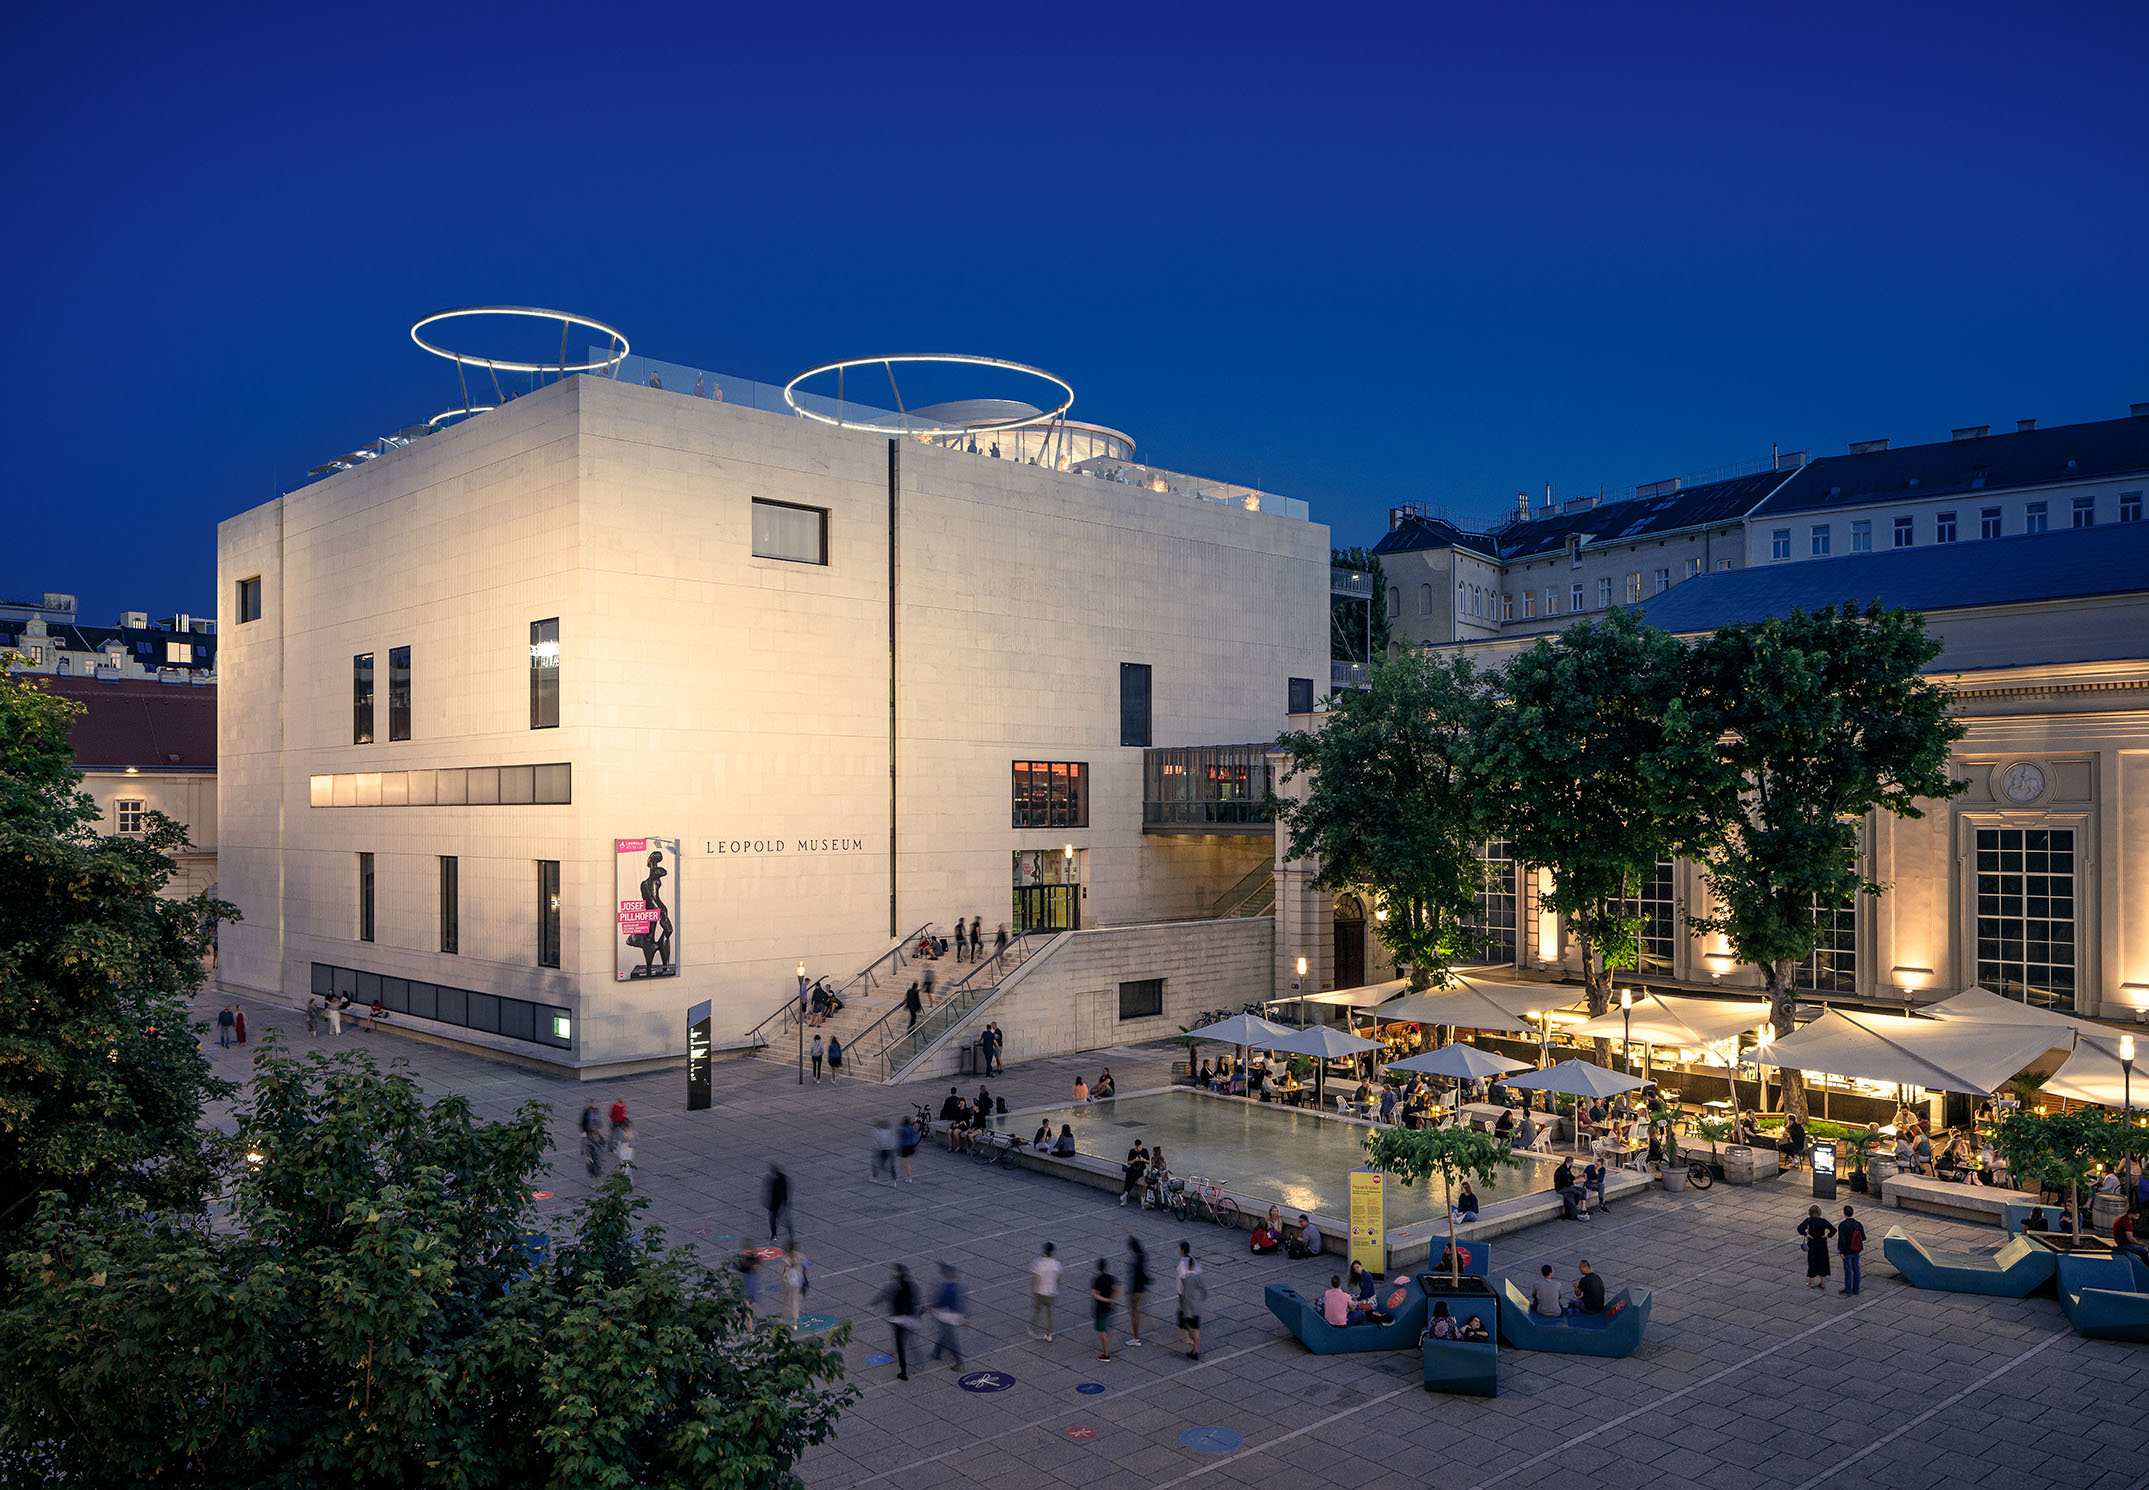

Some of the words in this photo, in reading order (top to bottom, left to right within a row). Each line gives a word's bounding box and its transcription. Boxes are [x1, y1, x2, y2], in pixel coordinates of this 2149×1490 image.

[707, 840, 785, 853] LEOPOLD
[798, 839, 862, 851] MUSEUM
[621, 901, 644, 910] JOSEF
[620, 911, 658, 921] PILLHOFER
